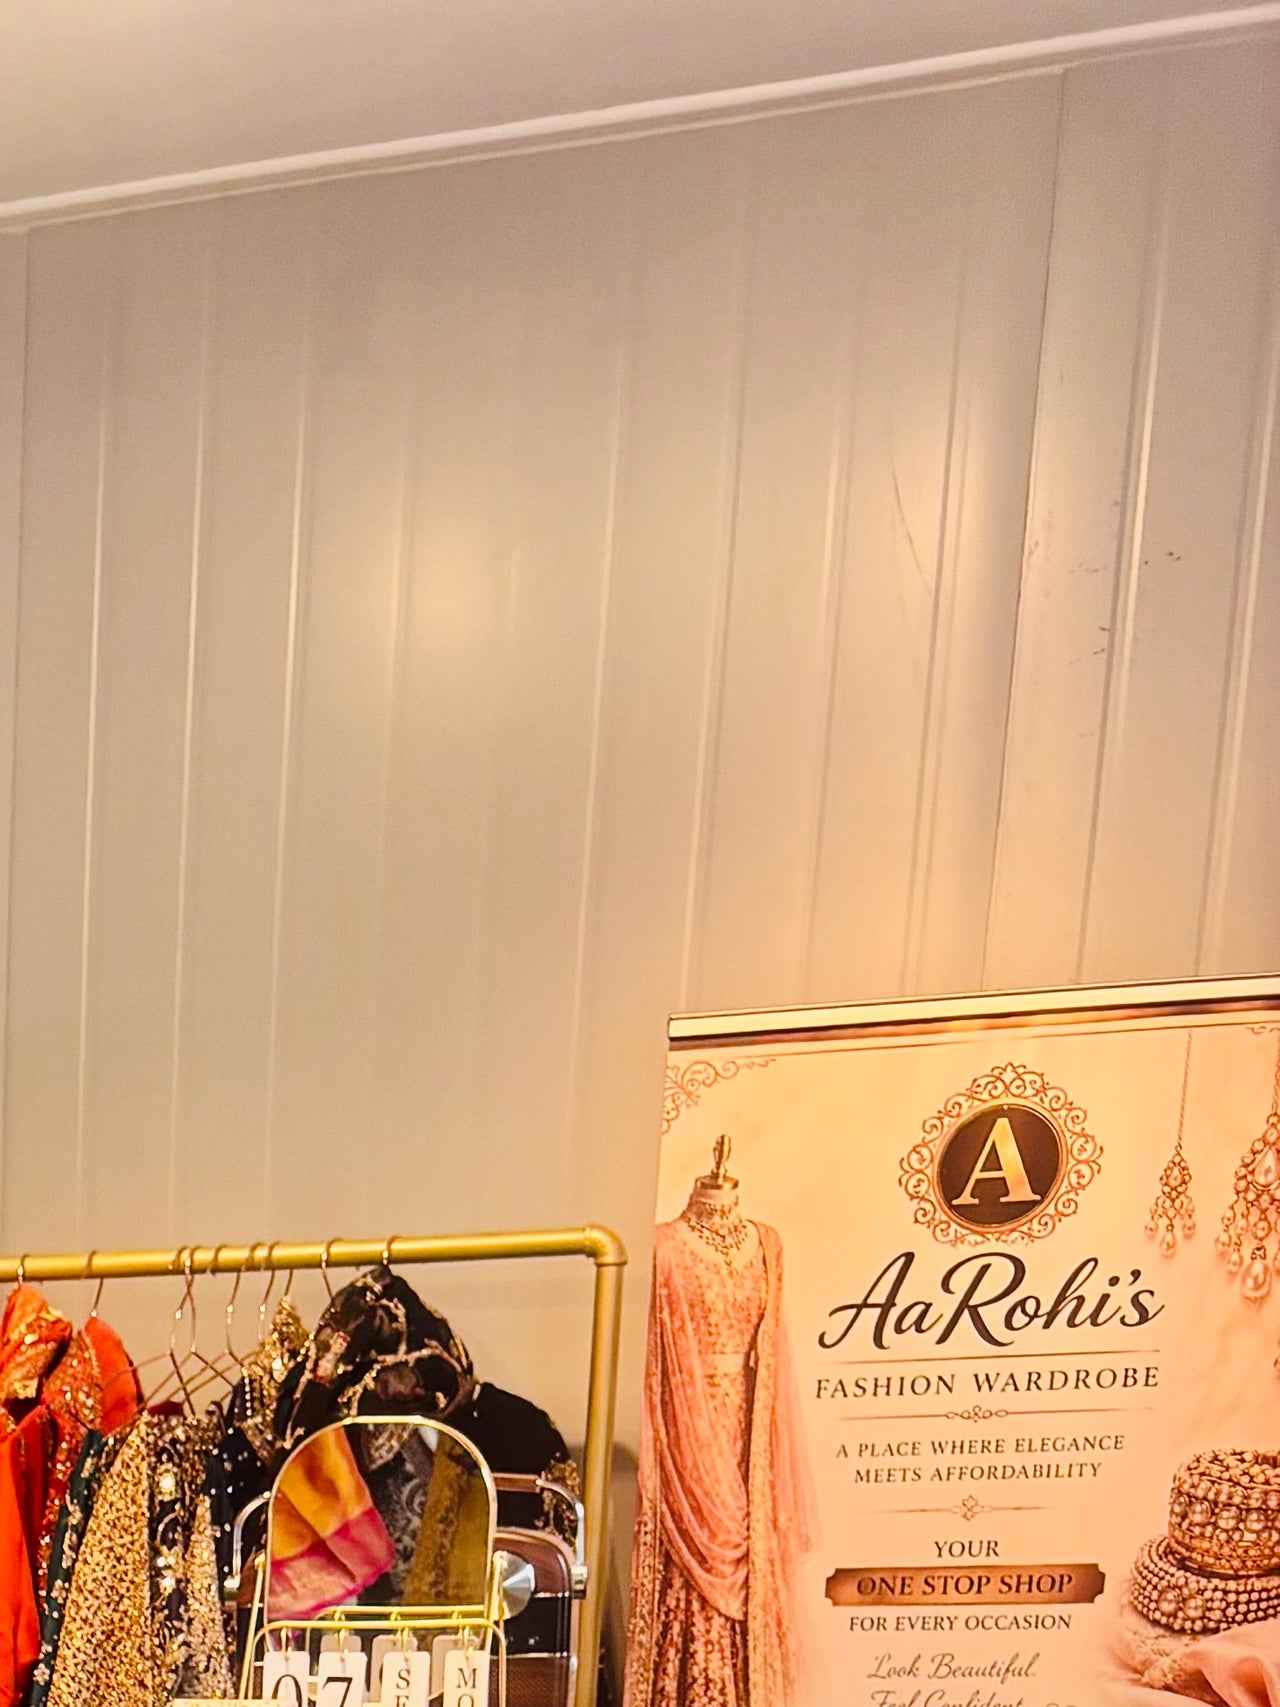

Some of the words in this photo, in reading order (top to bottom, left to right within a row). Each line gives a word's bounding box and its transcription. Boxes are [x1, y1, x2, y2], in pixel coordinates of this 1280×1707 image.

[951, 1117, 1042, 1206] A
[817, 1251, 1166, 1350] AaRohi's
[815, 1373, 956, 1399] FASHION
[973, 1366, 1161, 1394] WARDROBE
[835, 1443, 849, 1459] A
[858, 1440, 922, 1458] PLACE
[930, 1438, 1006, 1455] WHERE
[1015, 1434, 1126, 1453] ELEGANCE
[854, 1466, 922, 1484] MEETS
[930, 1462, 1103, 1482] AFFORDABILITY
[934, 1540, 1000, 1558] YOUR
[856, 1575, 914, 1596] ONE
[922, 1575, 991, 1596] STOP
[998, 1573, 1073, 1594] SHOP
[849, 1616, 888, 1632] FOR
[895, 1615, 959, 1632] EVERY
[965, 1613, 1072, 1631] OCCASION
[867, 1653, 921, 1680] Look
